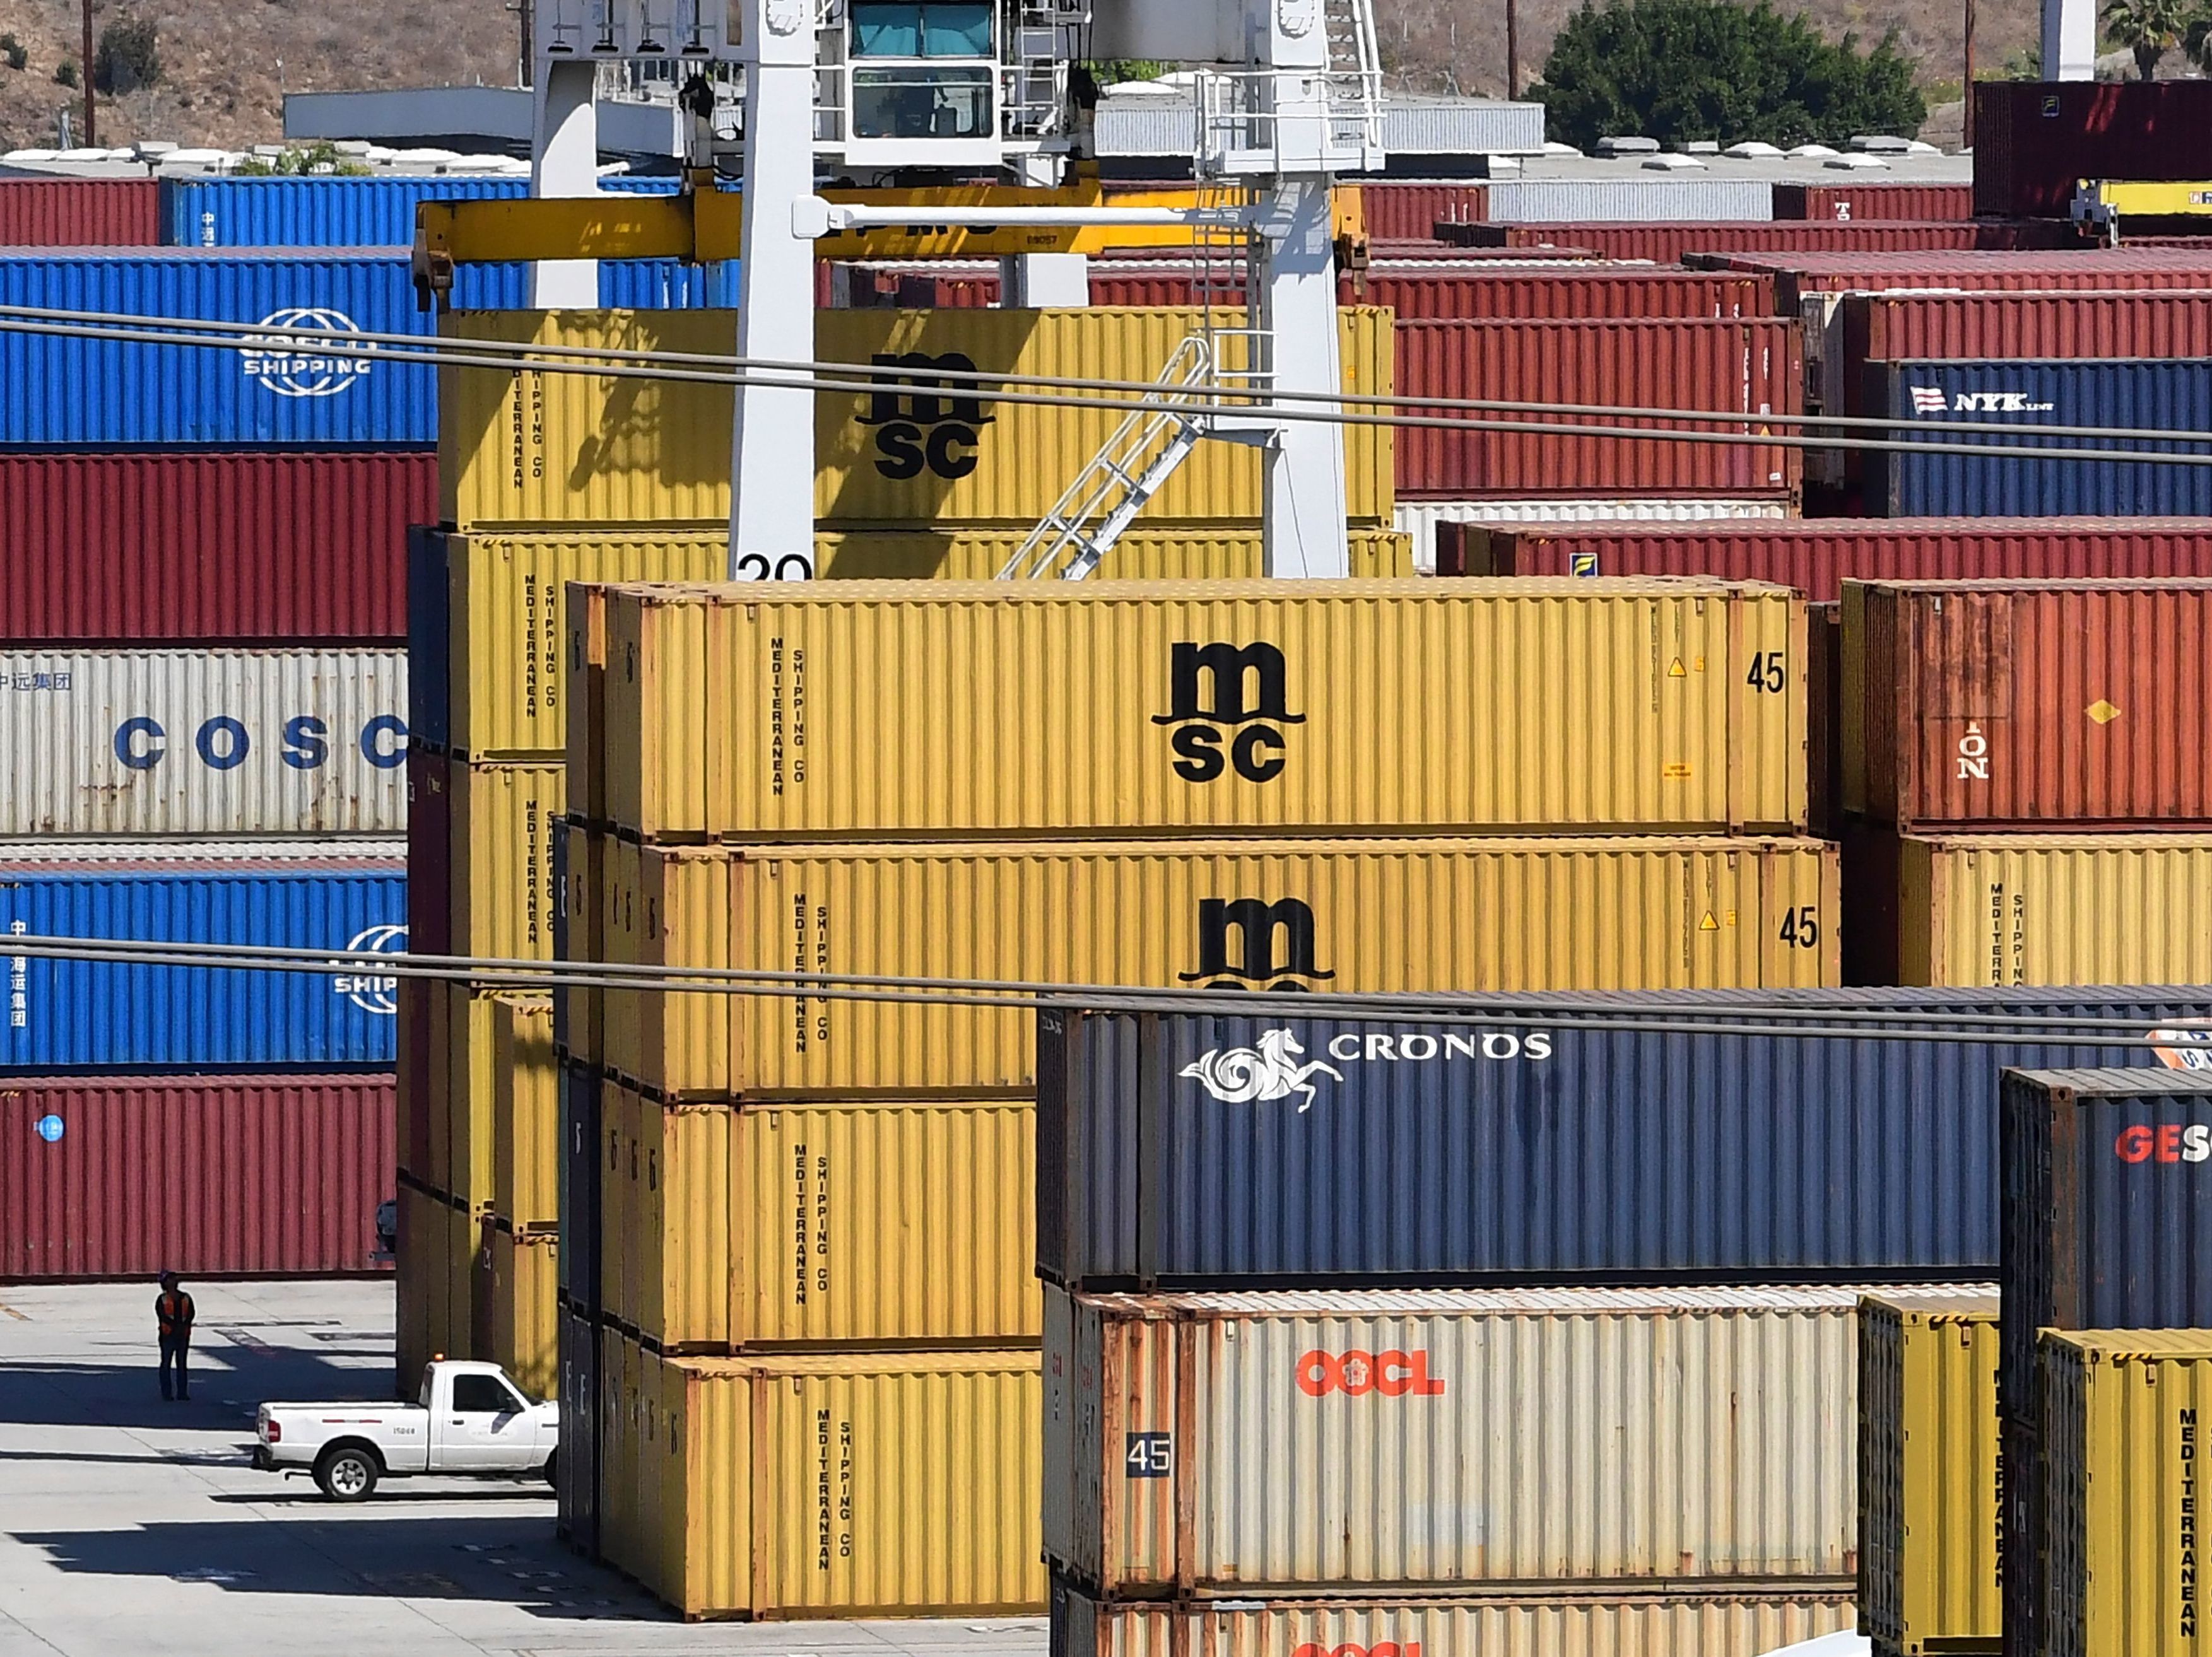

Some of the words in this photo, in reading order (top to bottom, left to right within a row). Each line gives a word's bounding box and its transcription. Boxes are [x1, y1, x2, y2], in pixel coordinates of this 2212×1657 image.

[244, 360, 371, 375] SHIPPING
[512, 351, 522, 489] DITERRANEAN
[532, 357, 542, 445] HIPPING
[1953, 392, 2028, 412] NYK
[532, 457, 542, 478] CO
[525, 575, 536, 717] MEDITERRANEAN
[545, 585, 555, 674] SHIPPING
[546, 685, 555, 707] CO
[1746, 652, 1784, 693] 45
[771, 638, 783, 796] MEDITERRANEAN
[793, 650, 804, 746] SHIPPING
[794, 760, 804, 783] CO
[526, 800, 538, 944] MEDITERRANEAN
[1779, 906, 1818, 949] 45
[10, 919, 26, 1028] 中海运集团
[817, 1017, 828, 1040] CO
[1328, 1032, 1553, 1061] CRONOS
[2115, 1124, 2212, 1164] GES
[795, 1144, 806, 1305] MEDITERRANEAN
[817, 1156, 827, 1255] SHIPPING
[817, 1268, 828, 1291] CO
[1295, 1349, 1446, 1397] OOCL
[840, 1422, 850, 1521] SHIPPING
[1127, 1439, 1170, 1471] 45
[818, 1408, 830, 1571] MEDITERRANEAN
[840, 1533, 850, 1557] CO
[2180, 1408, 2197, 1638] MEDITERRANEAN
